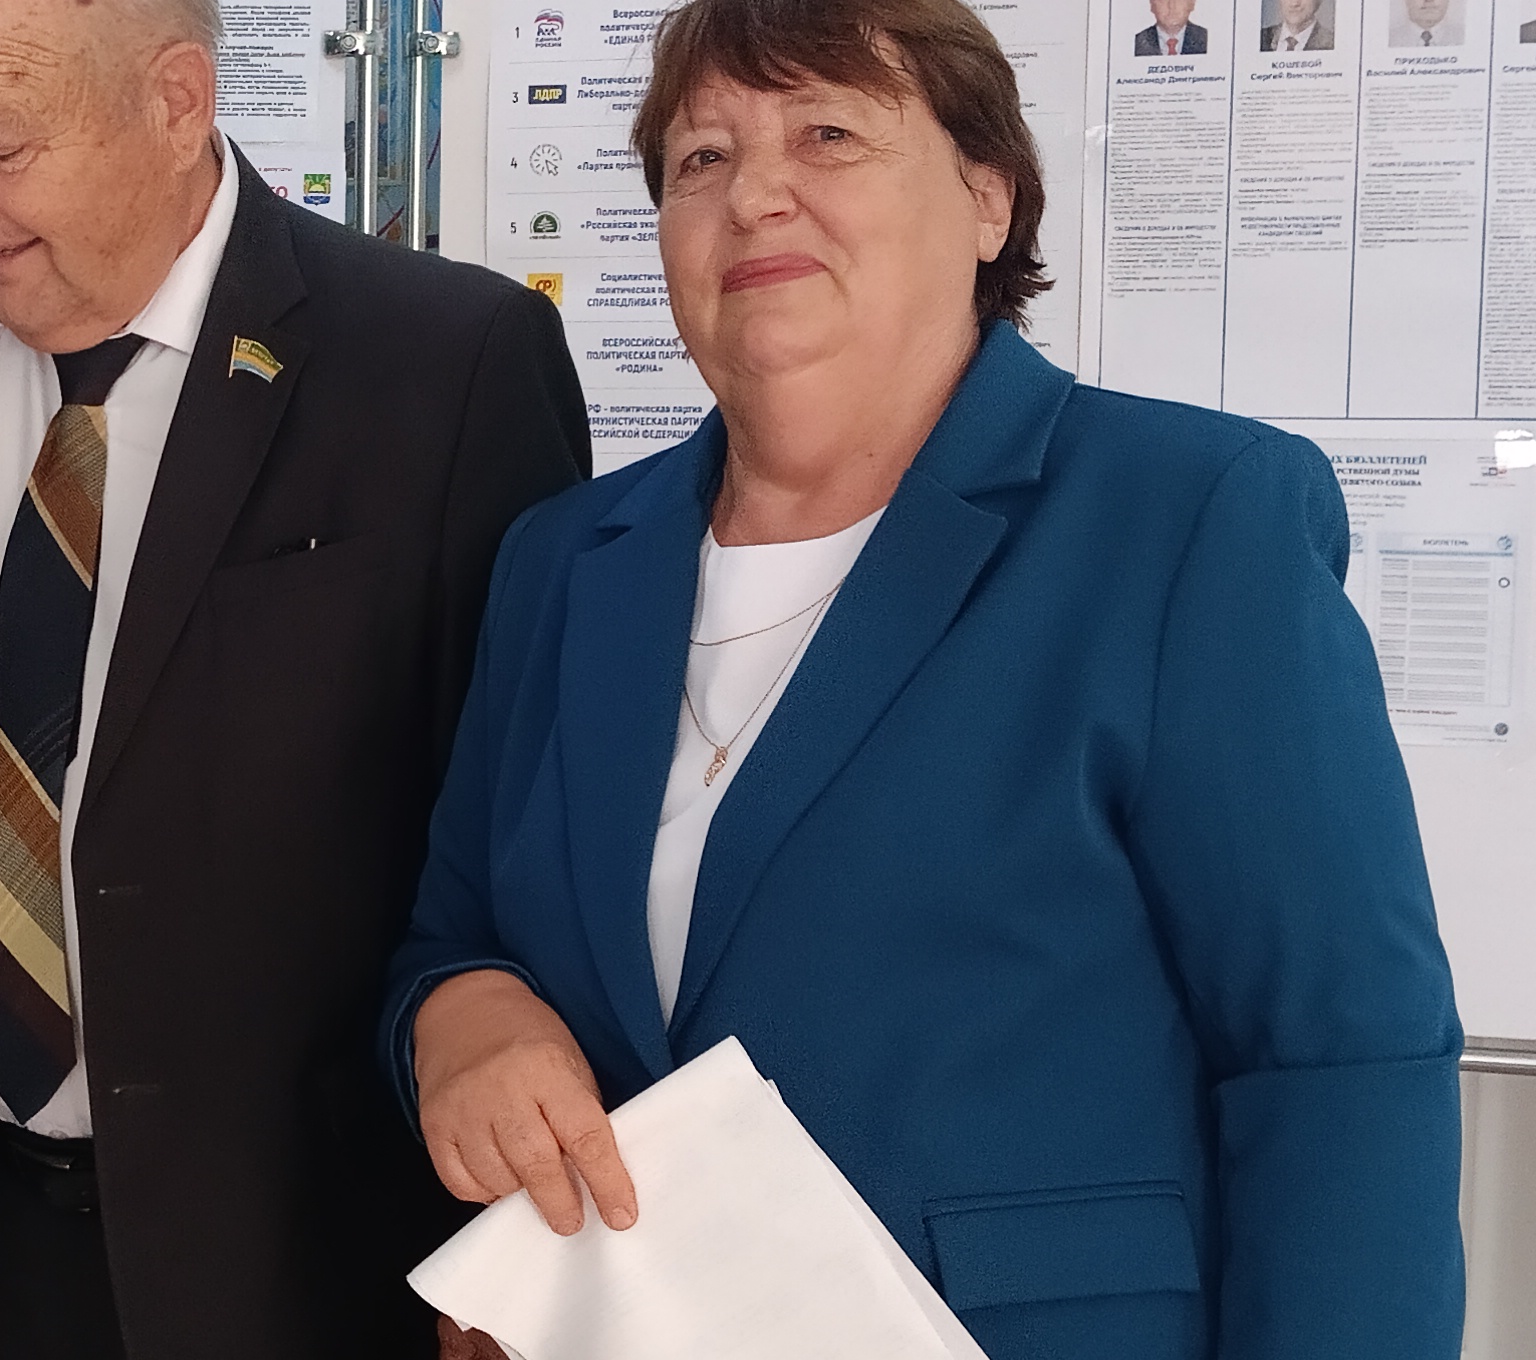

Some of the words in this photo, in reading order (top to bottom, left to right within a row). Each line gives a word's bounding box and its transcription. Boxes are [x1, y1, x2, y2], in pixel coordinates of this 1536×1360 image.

[515, 26, 520, 38] 1
[581, 76, 642, 86] Политическая
[512, 91, 519, 103] 3
[532, 88, 563, 101] ЛДПР
[510, 157, 518, 169] 4
[577, 161, 614, 172] «Партия
[596, 207, 657, 217] Политическая
[510, 221, 517, 234] 5
[595, 286, 656, 295] политическая
[587, 297, 658, 307] СПРАВЕДЛИВАЯ
[602, 336, 678, 347] ВСЕРОССИЙСКАЯ
[586, 350, 657, 360] ПОЛИТИЧЕСКАЯ
[615, 363, 663, 374] «РОДИНА»
[588, 404, 602, 414] РФ
[610, 405, 670, 414] политическая
[672, 405, 703, 415] партия
